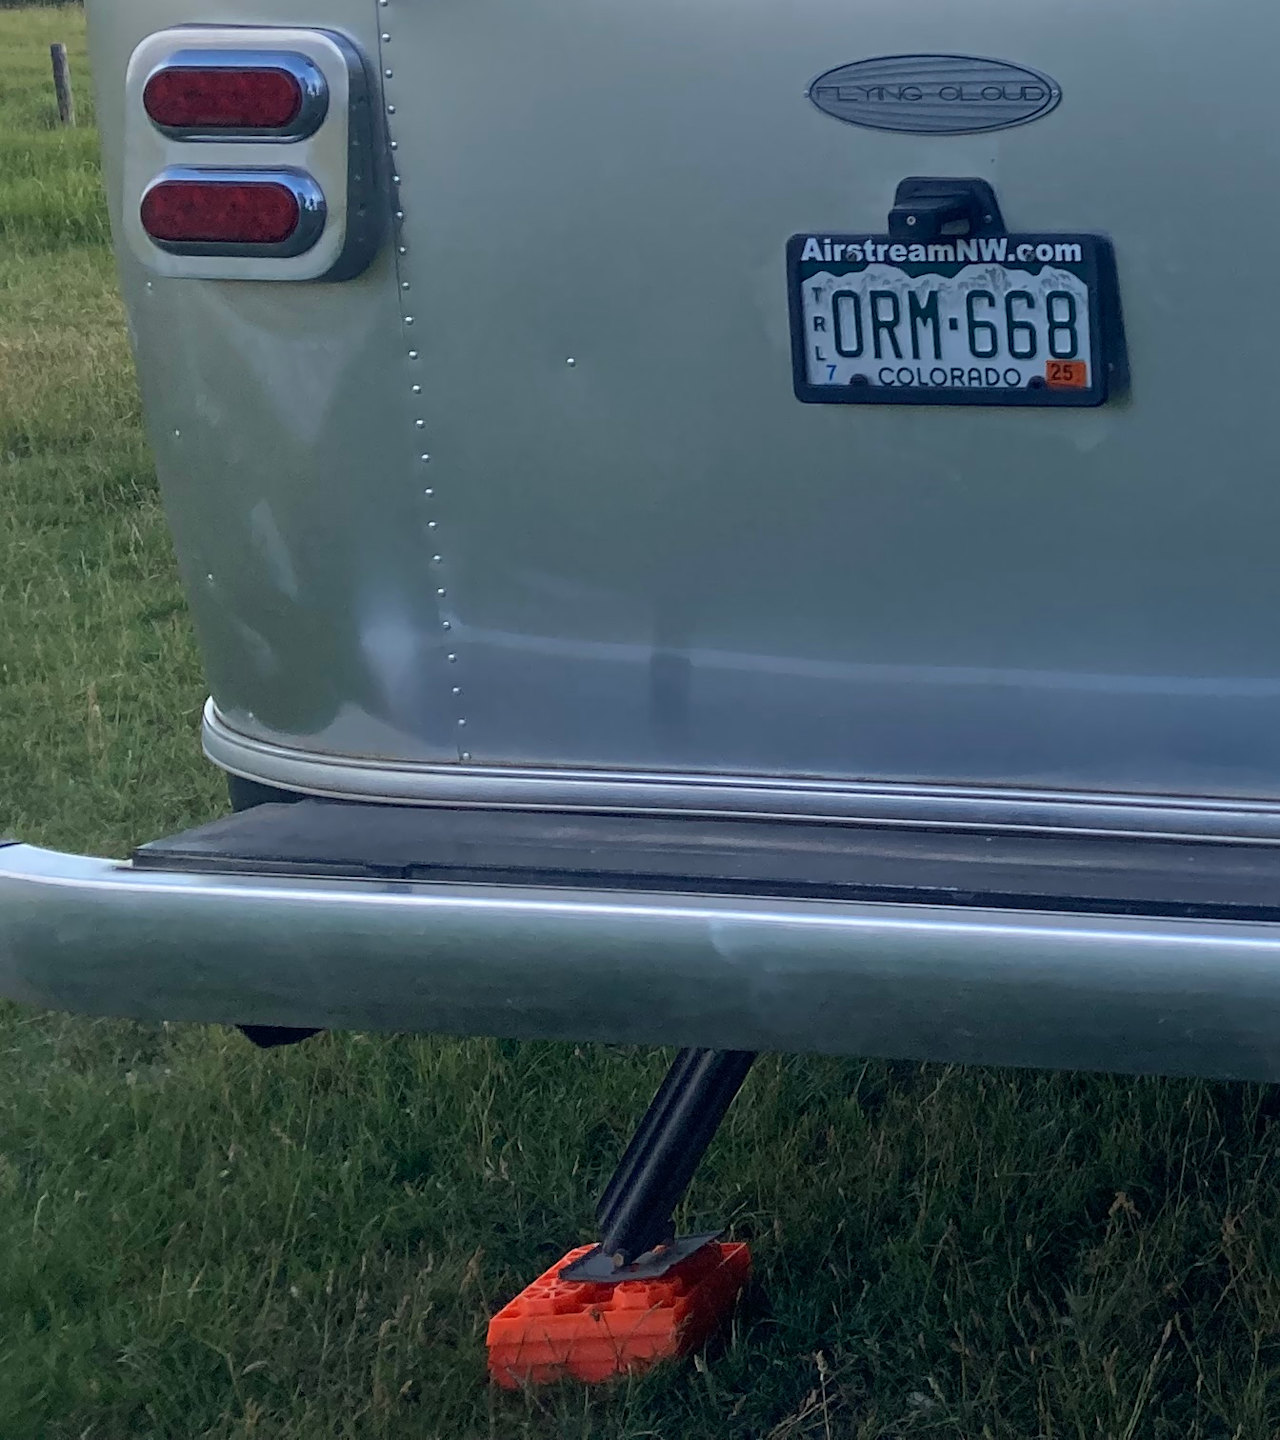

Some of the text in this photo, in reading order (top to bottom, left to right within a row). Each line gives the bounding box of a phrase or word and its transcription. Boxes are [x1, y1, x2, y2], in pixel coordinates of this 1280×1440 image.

[800, 238, 1082, 262] AirstreamNW.com
[826, 364, 838, 381] 7
[878, 366, 1021, 388] COLORADO
[1050, 363, 1073, 381] 25
